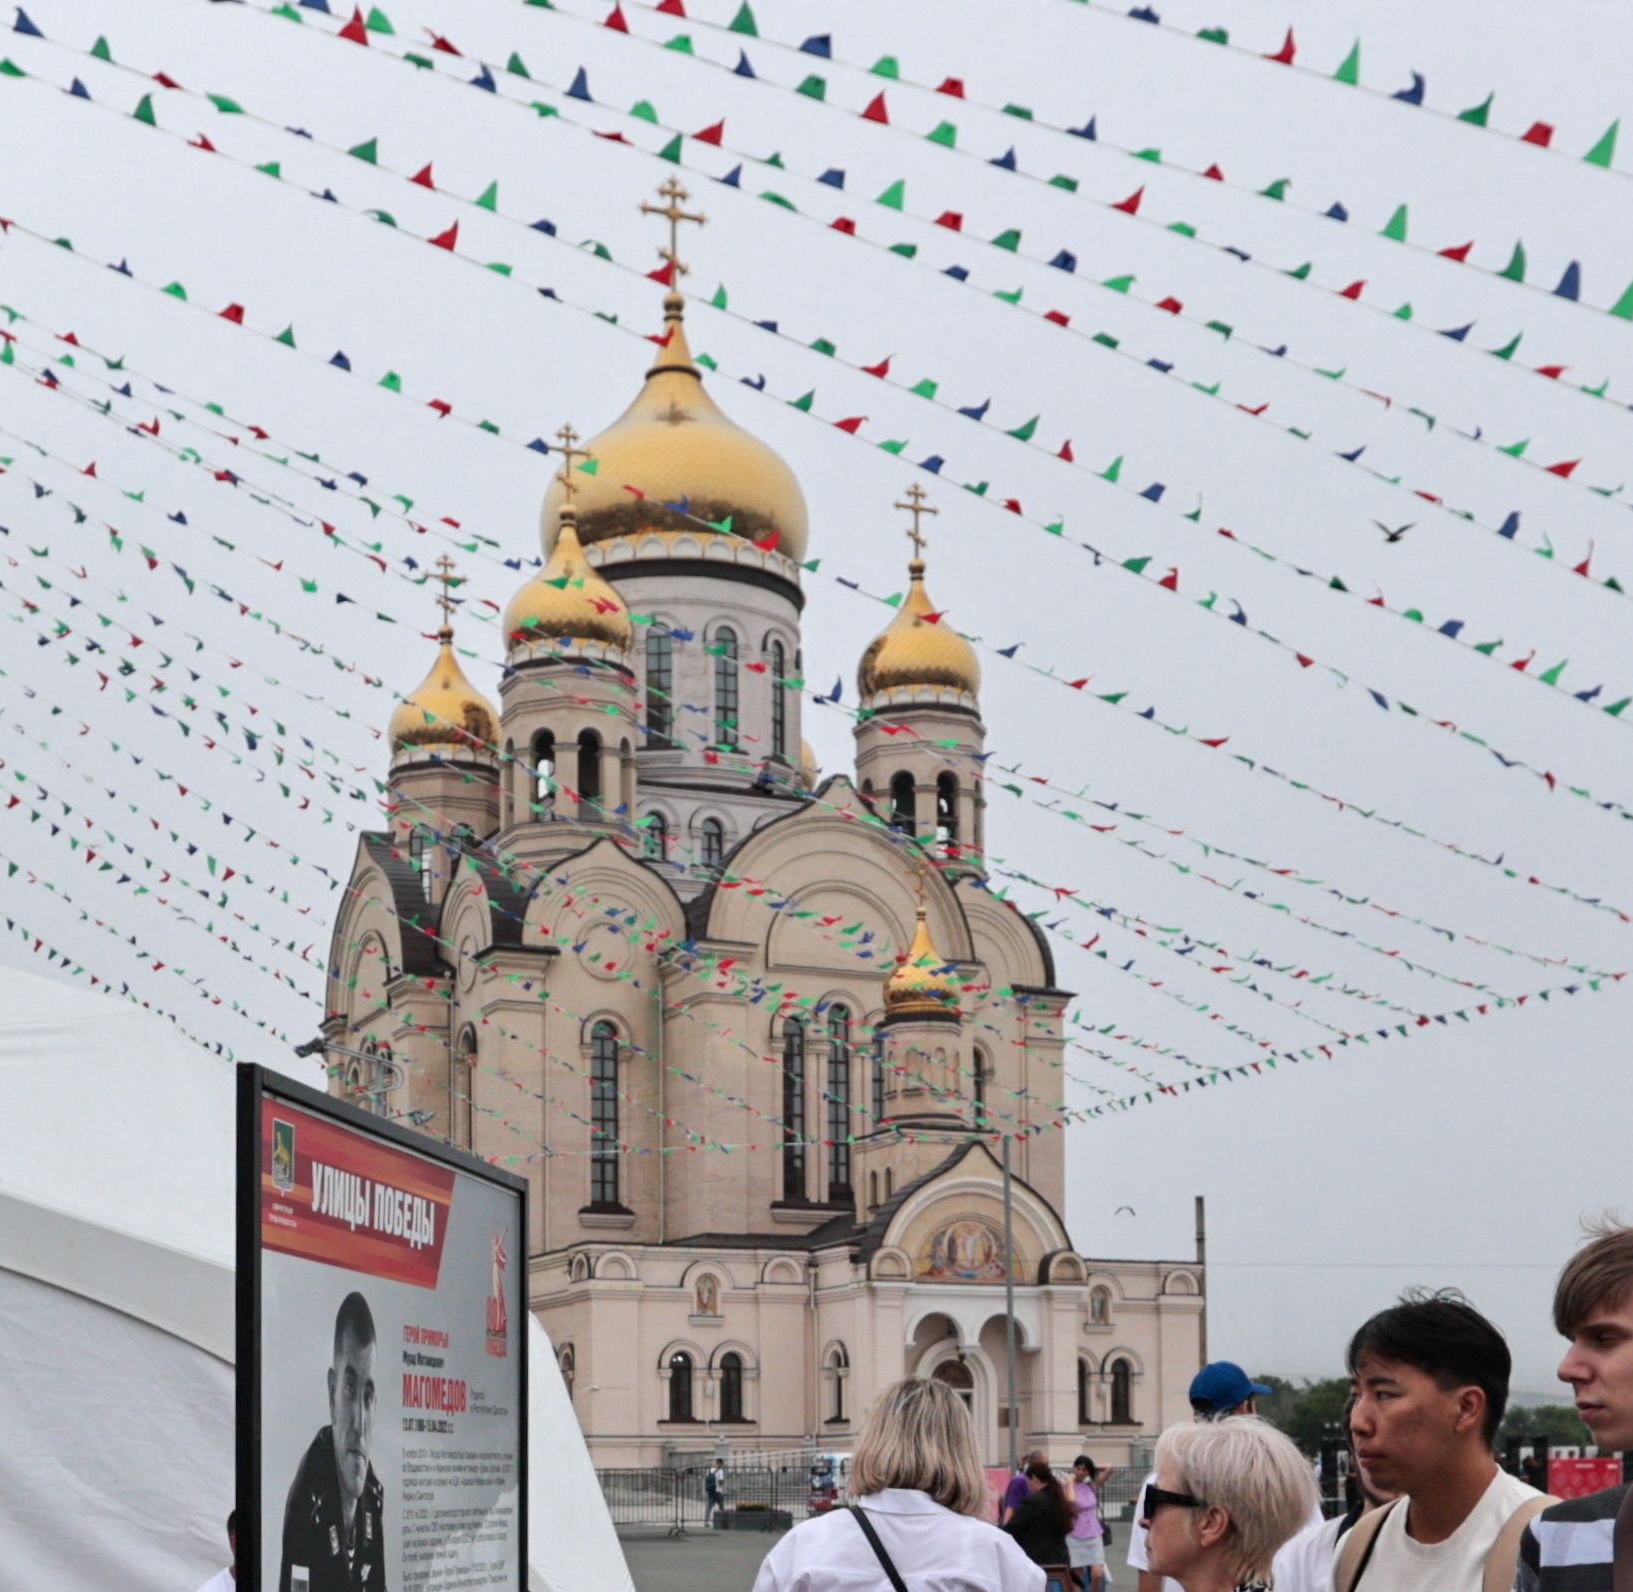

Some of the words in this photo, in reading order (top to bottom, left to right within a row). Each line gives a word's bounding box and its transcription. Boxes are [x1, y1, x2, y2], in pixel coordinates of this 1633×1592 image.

[312, 1161, 370, 1232] УЛИЦЫ
[374, 1183, 435, 1251] ПОБЕДЫ
[402, 1373, 467, 1417] МАГОМЕДОВ
